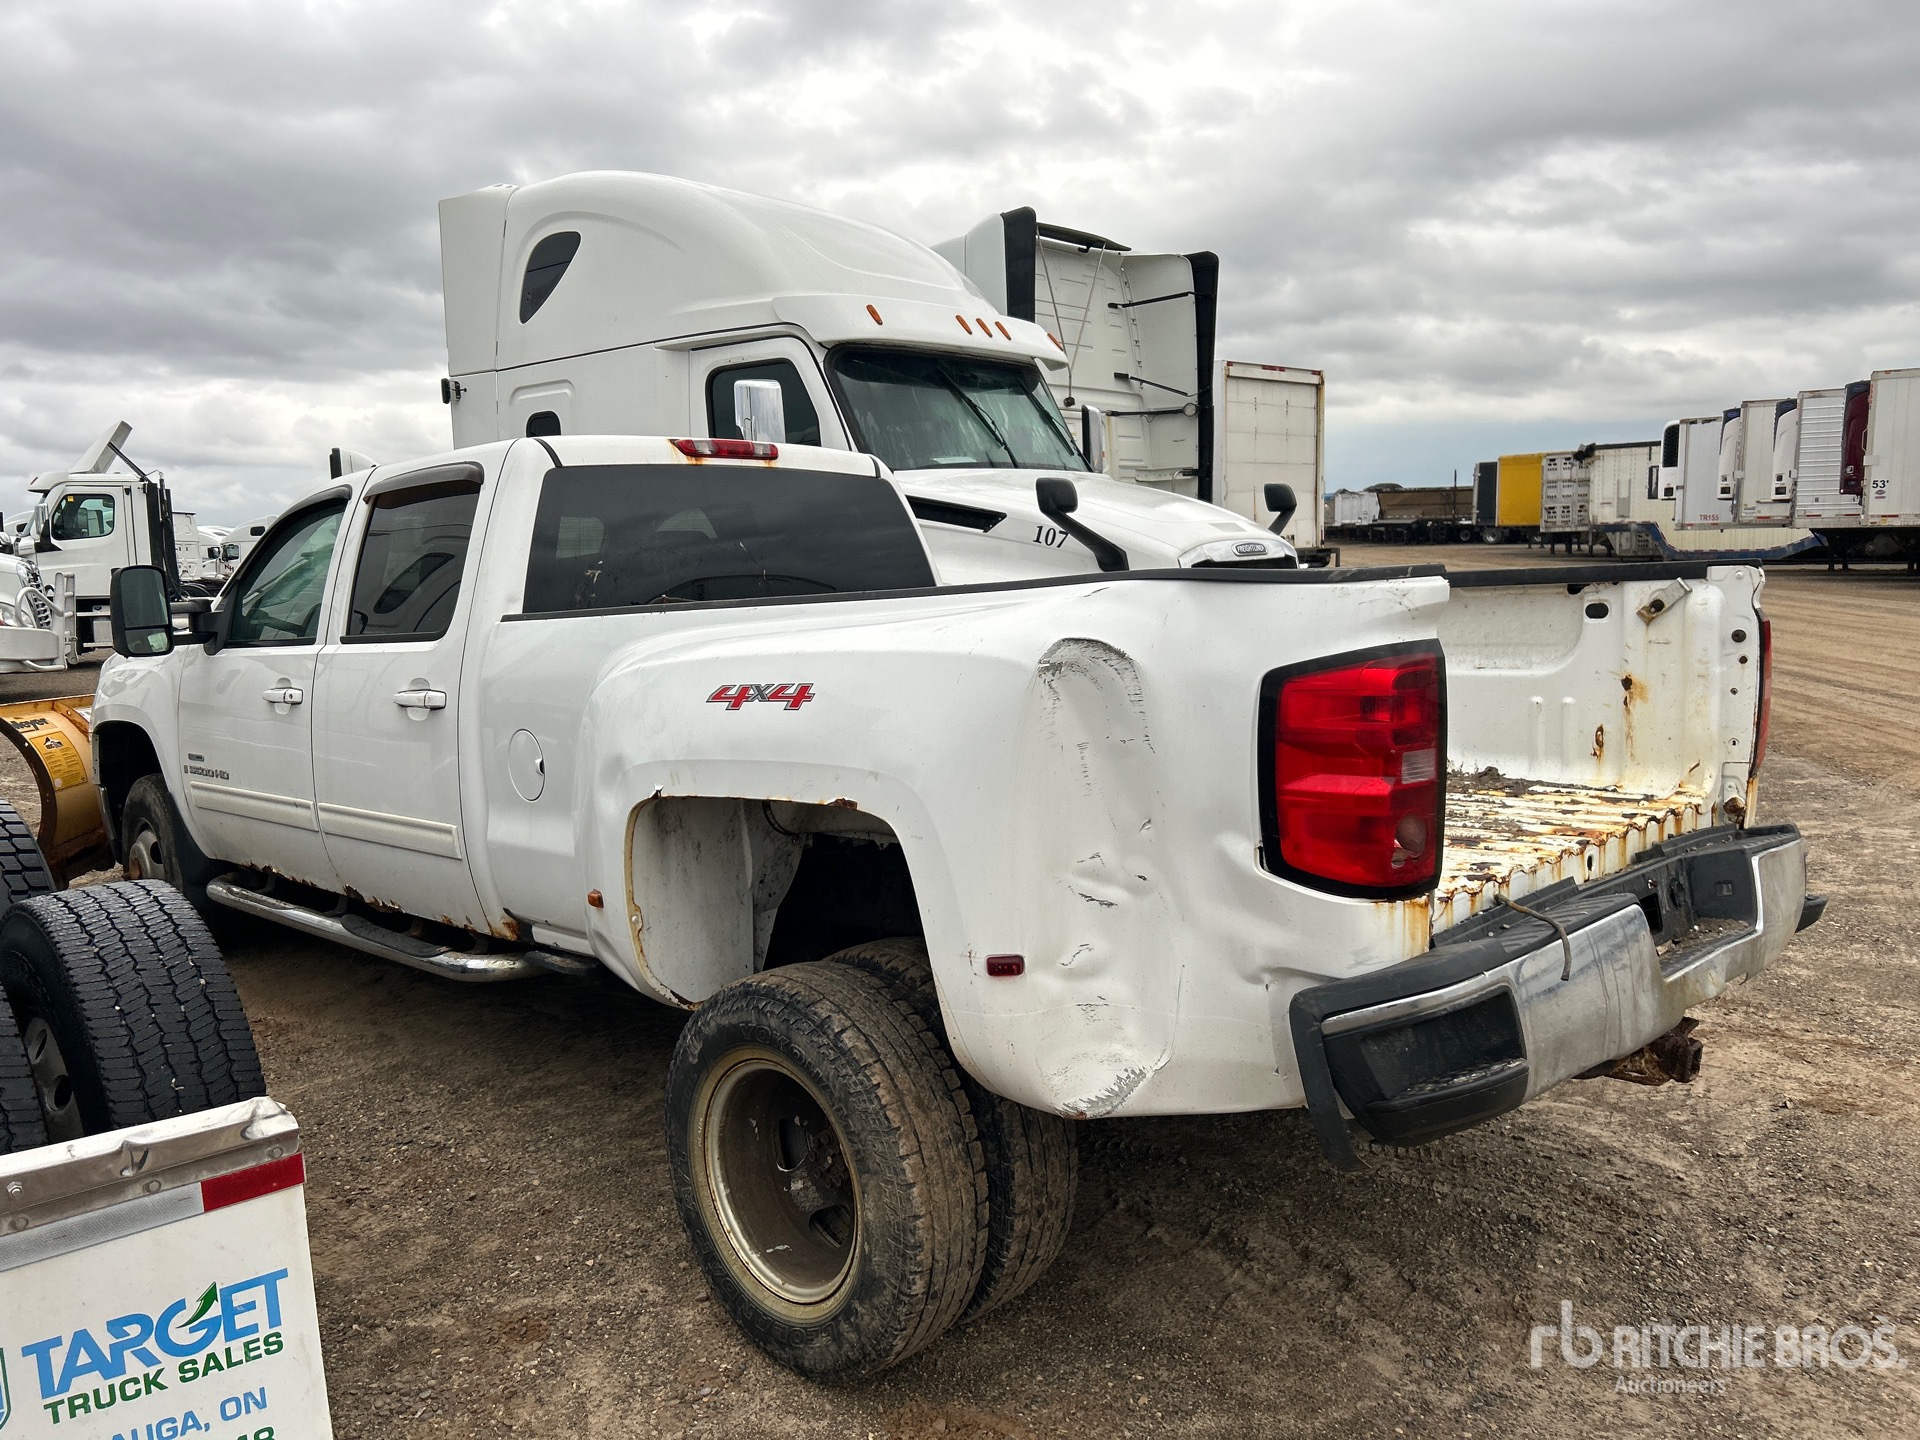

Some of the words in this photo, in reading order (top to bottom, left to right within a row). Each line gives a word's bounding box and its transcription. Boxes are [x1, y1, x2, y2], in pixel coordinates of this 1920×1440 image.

[1033, 526, 1069, 548] 107
[21, 1268, 289, 1400] TARGET
[43, 1367, 169, 1425] TRUCK
[178, 1331, 284, 1383] SALES
[219, 1387, 268, 1422] ON
